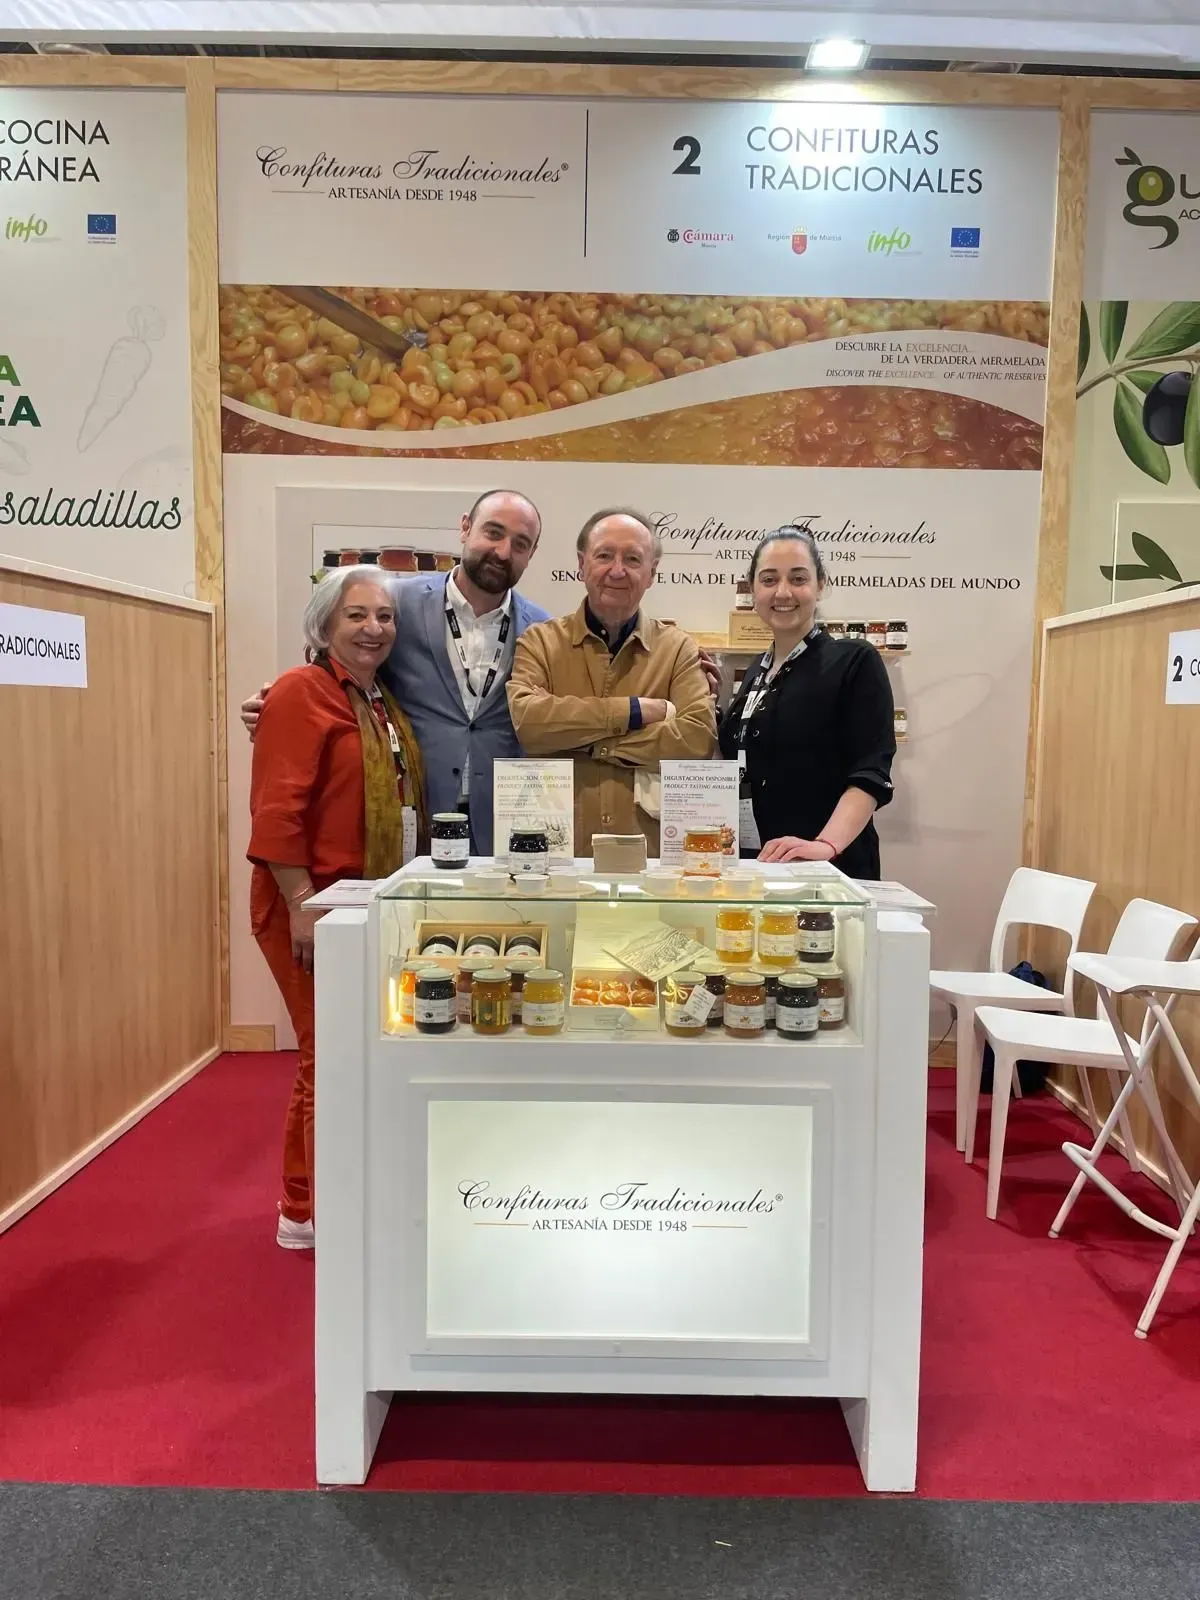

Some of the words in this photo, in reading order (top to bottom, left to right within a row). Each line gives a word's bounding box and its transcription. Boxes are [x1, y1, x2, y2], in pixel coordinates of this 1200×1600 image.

[0, 119, 110, 145] OCINA
[746, 126, 939, 155] CONFITURAS
[256, 145, 383, 187] Confituras
[672, 135, 702, 175] 2
[745, 164, 984, 194] TRADICIONALES
[328, 187, 401, 200] ARTESANÍA
[405, 189, 444, 201] DESDE
[449, 190, 477, 201] 1948
[5, 213, 48, 243] info
[867, 227, 911, 256] info
[835, 341, 886, 352] DESCUBRE
[890, 343, 902, 352] LA
[881, 354, 893, 364] DE
[897, 354, 909, 364] LA
[914, 355, 977, 365] VERDADERA
[980, 356, 1045, 366] MERMELADA
[826, 368, 865, 378] DISCOVER
[867, 369, 883, 378] THE
[943, 371, 956, 379] OF
[956, 371, 1003, 380] AUTHENTIC
[1004, 372, 1047, 381] PRESERVES
[0, 395, 41, 427] A
[0, 488, 181, 530] saladillas
[649, 511, 766, 550] Confituras
[829, 551, 856, 562] 1948
[671, 573, 703, 584] UNA
[708, 574, 726, 584] DE
[827, 576, 925, 588] MERMELADAS
[930, 577, 956, 588] DEL
[961, 578, 1020, 589] MUNDO
[1172, 655, 1183, 682] 2
[458, 1180, 588, 1219] Confituras
[532, 1218, 608, 1231] ARTESANÍA
[613, 1220, 653, 1231] DESDE
[658, 1220, 687, 1231] 1948
